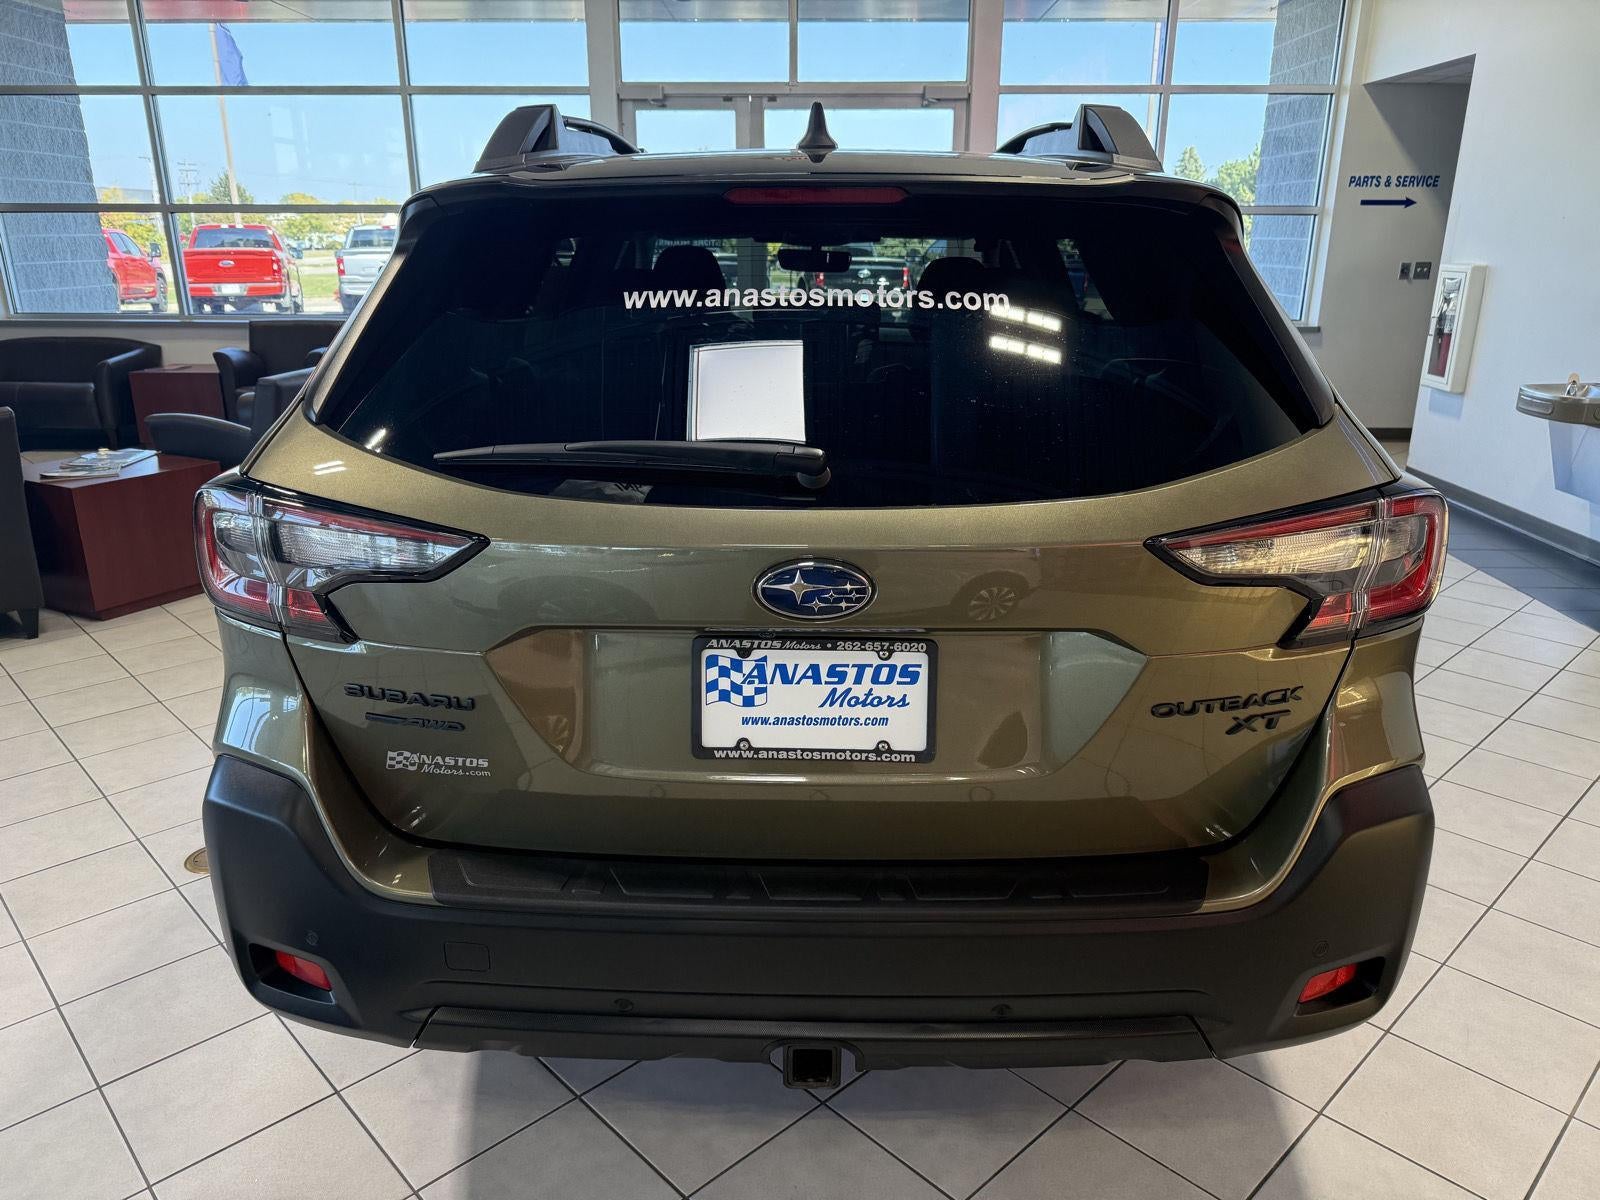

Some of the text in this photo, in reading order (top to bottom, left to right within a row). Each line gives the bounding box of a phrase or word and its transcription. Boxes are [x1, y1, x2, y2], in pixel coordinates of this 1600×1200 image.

[1348, 175, 1440, 188] PARTS & SERVICE
[623, 284, 1010, 313] www.anastosmotors.com
[705, 639, 927, 652] ANASTOS Motors 262-657-6020
[741, 661, 922, 686] ANASTOS
[343, 683, 476, 711] SUBARU
[818, 687, 910, 708] Motors
[1151, 685, 1304, 718] OUTBACK
[404, 717, 466, 731] AWD
[741, 714, 889, 728] www.anastosmotors.com
[1225, 709, 1292, 736] XT
[404, 752, 489, 768] ANASTOS
[714, 748, 917, 763] www.anastosmotors.com
